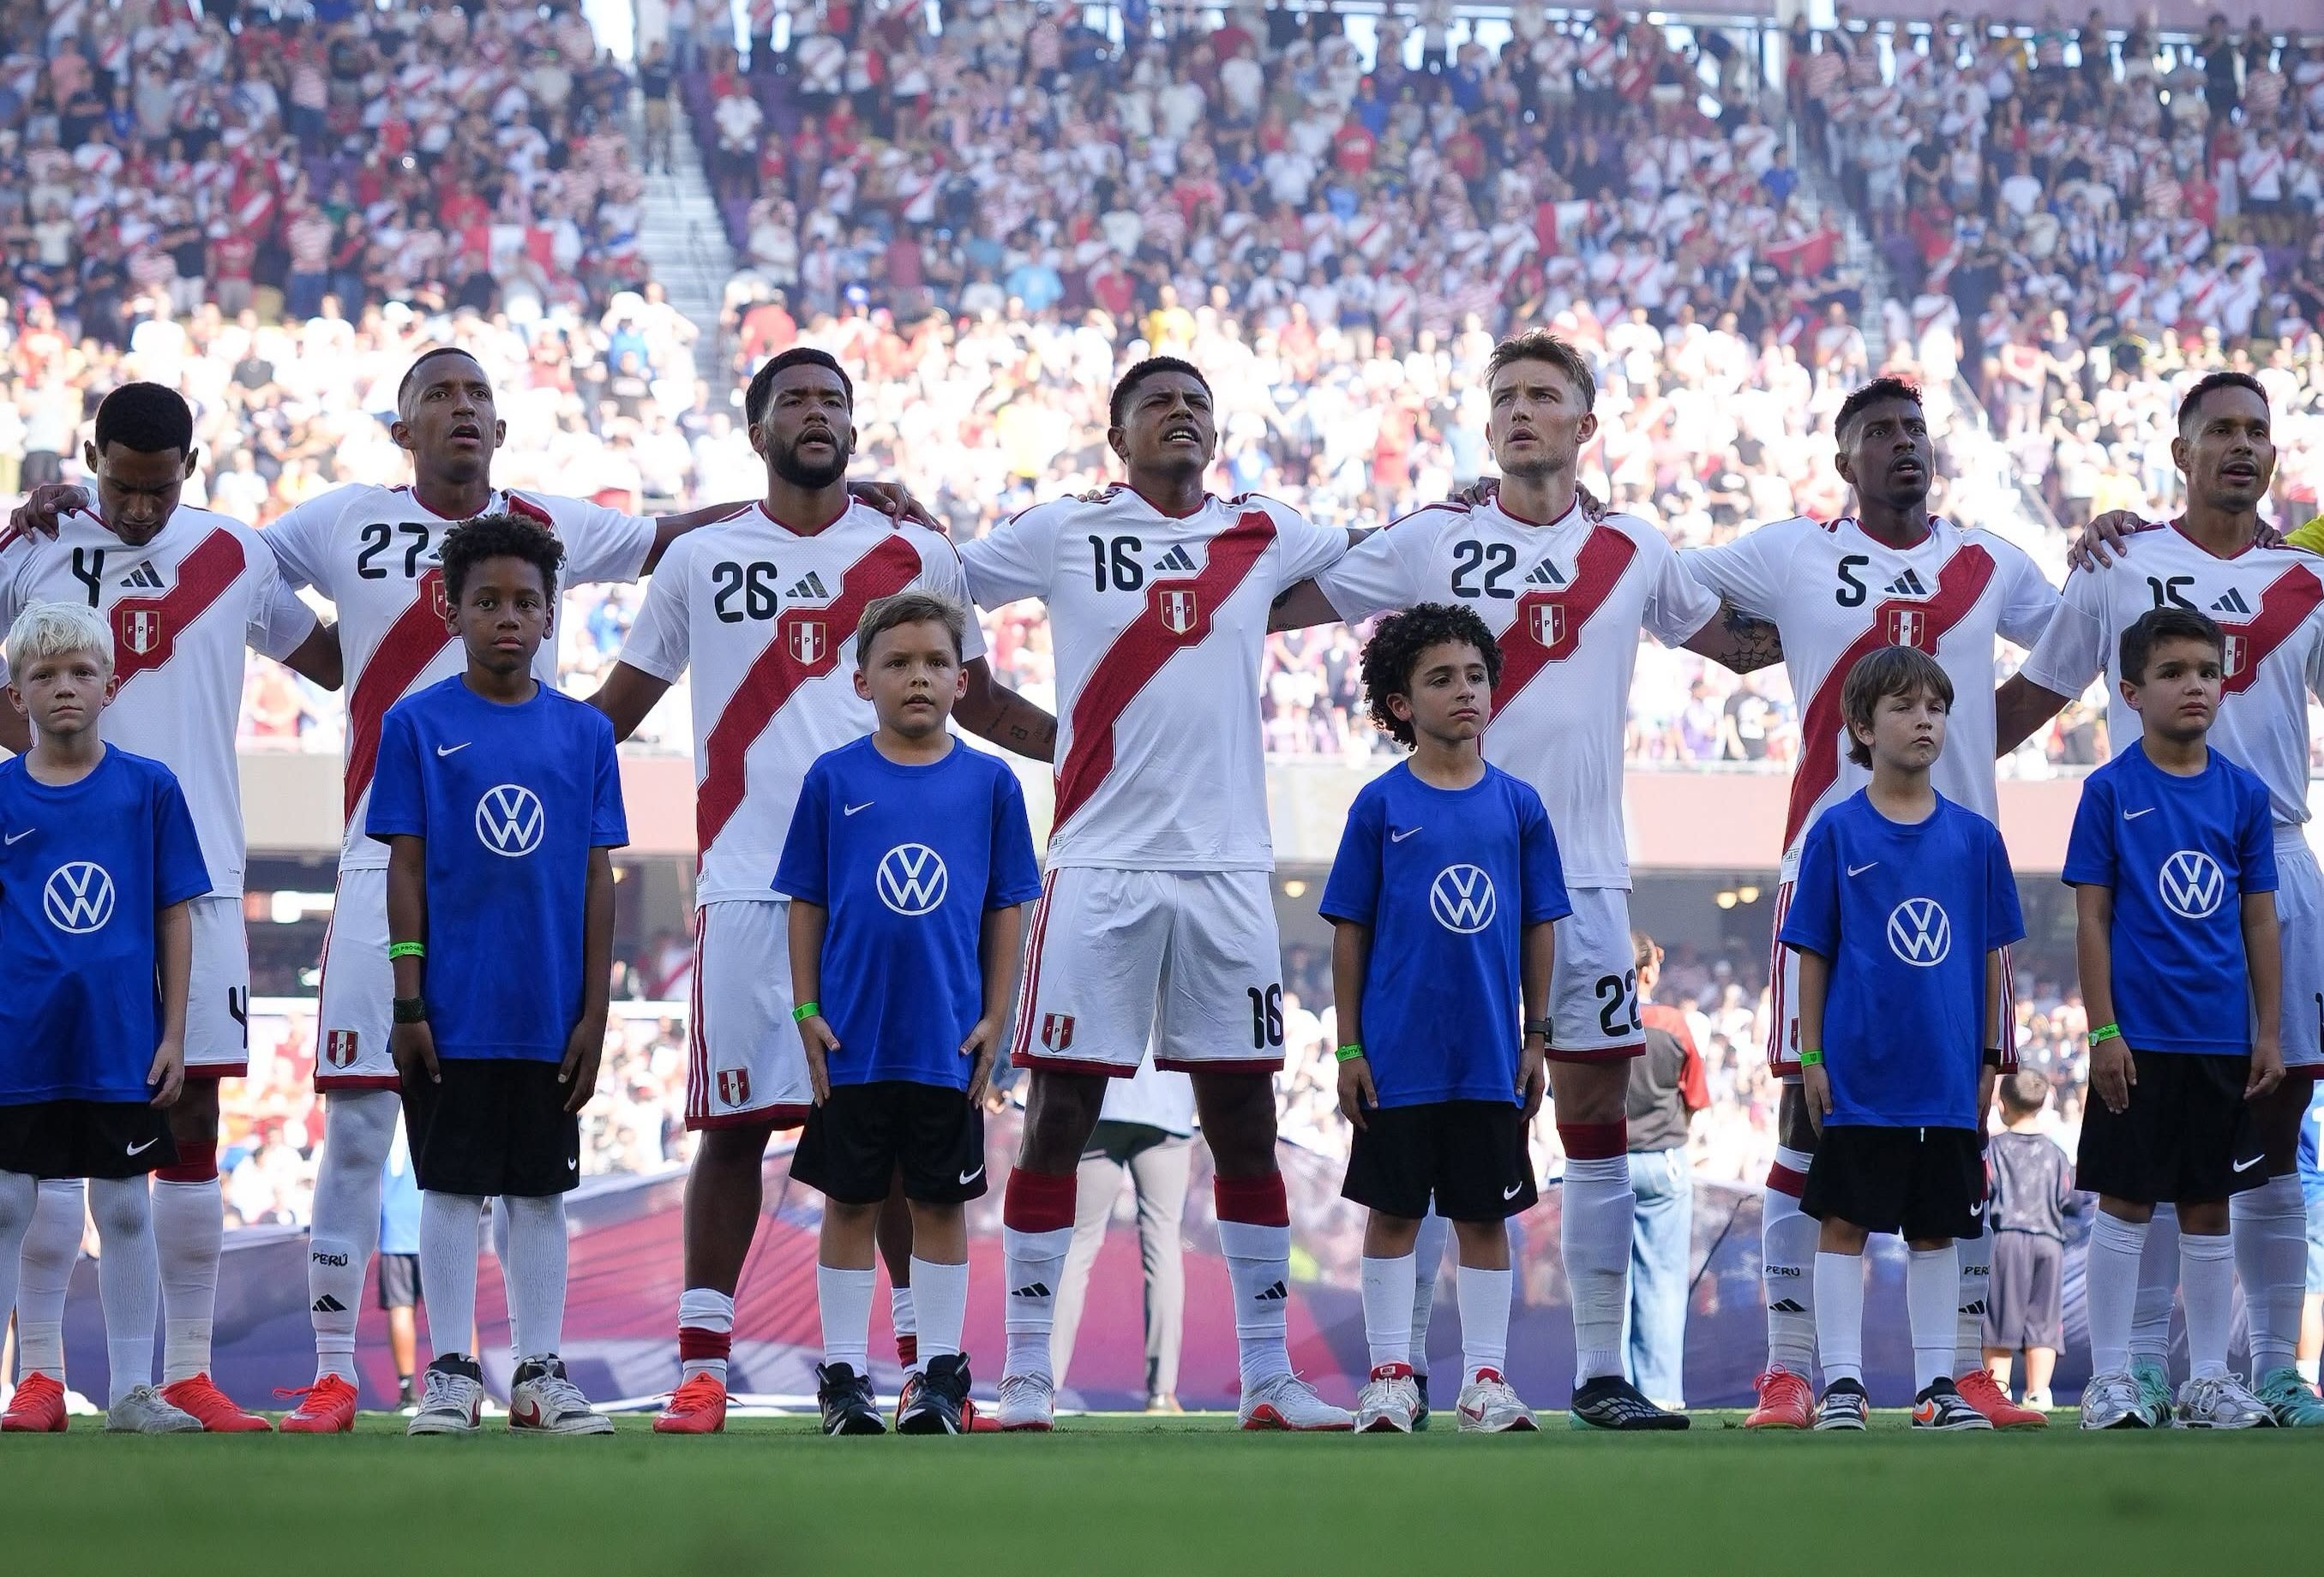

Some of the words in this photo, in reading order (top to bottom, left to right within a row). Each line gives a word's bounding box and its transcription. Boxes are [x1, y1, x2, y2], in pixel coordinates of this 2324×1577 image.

[72, 547, 105, 609] 4
[357, 522, 429, 579] 27
[1088, 534, 1144, 593] 16
[1451, 539, 1516, 599] 22
[1835, 555, 1870, 608] 5
[712, 561, 778, 623] 26
[477, 786, 542, 854] VW
[45, 864, 113, 932] VW
[878, 845, 946, 914] VW
[1432, 866, 1494, 932] VW
[2161, 853, 2222, 916] VW
[1889, 900, 1949, 964] VW
[1247, 983, 1283, 1049] 16
[1765, 1264, 1800, 1277] PERÚ
[1964, 1265, 1991, 1276] PER
